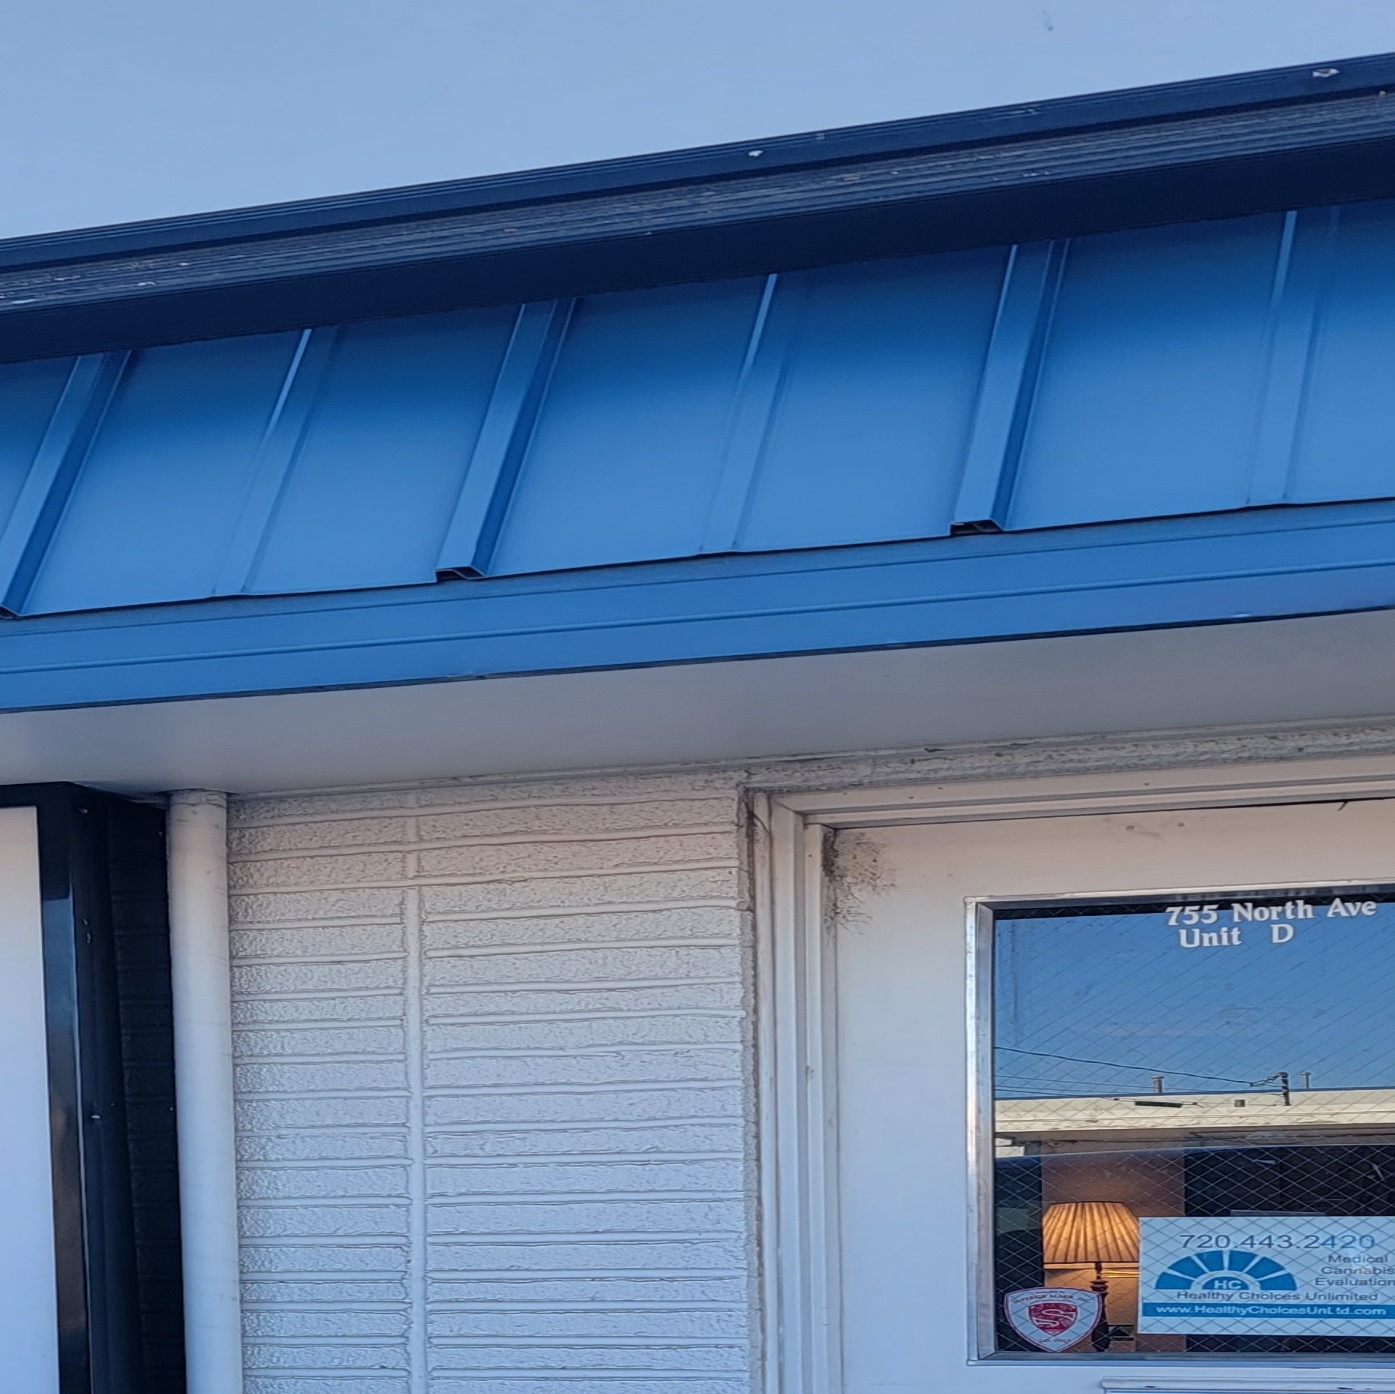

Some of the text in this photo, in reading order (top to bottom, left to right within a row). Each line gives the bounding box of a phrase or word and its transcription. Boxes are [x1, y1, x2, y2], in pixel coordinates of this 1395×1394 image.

[1165, 898, 1377, 926] 755 North Ave
[1179, 924, 1294, 948] Unit D
[1180, 1234, 1375, 1249] 720.443.2420
[1328, 1255, 1388, 1264] Medical
[1214, 1280, 1242, 1289] HC
[1177, 1291, 1378, 1301] Healthy Choices Unlimited
